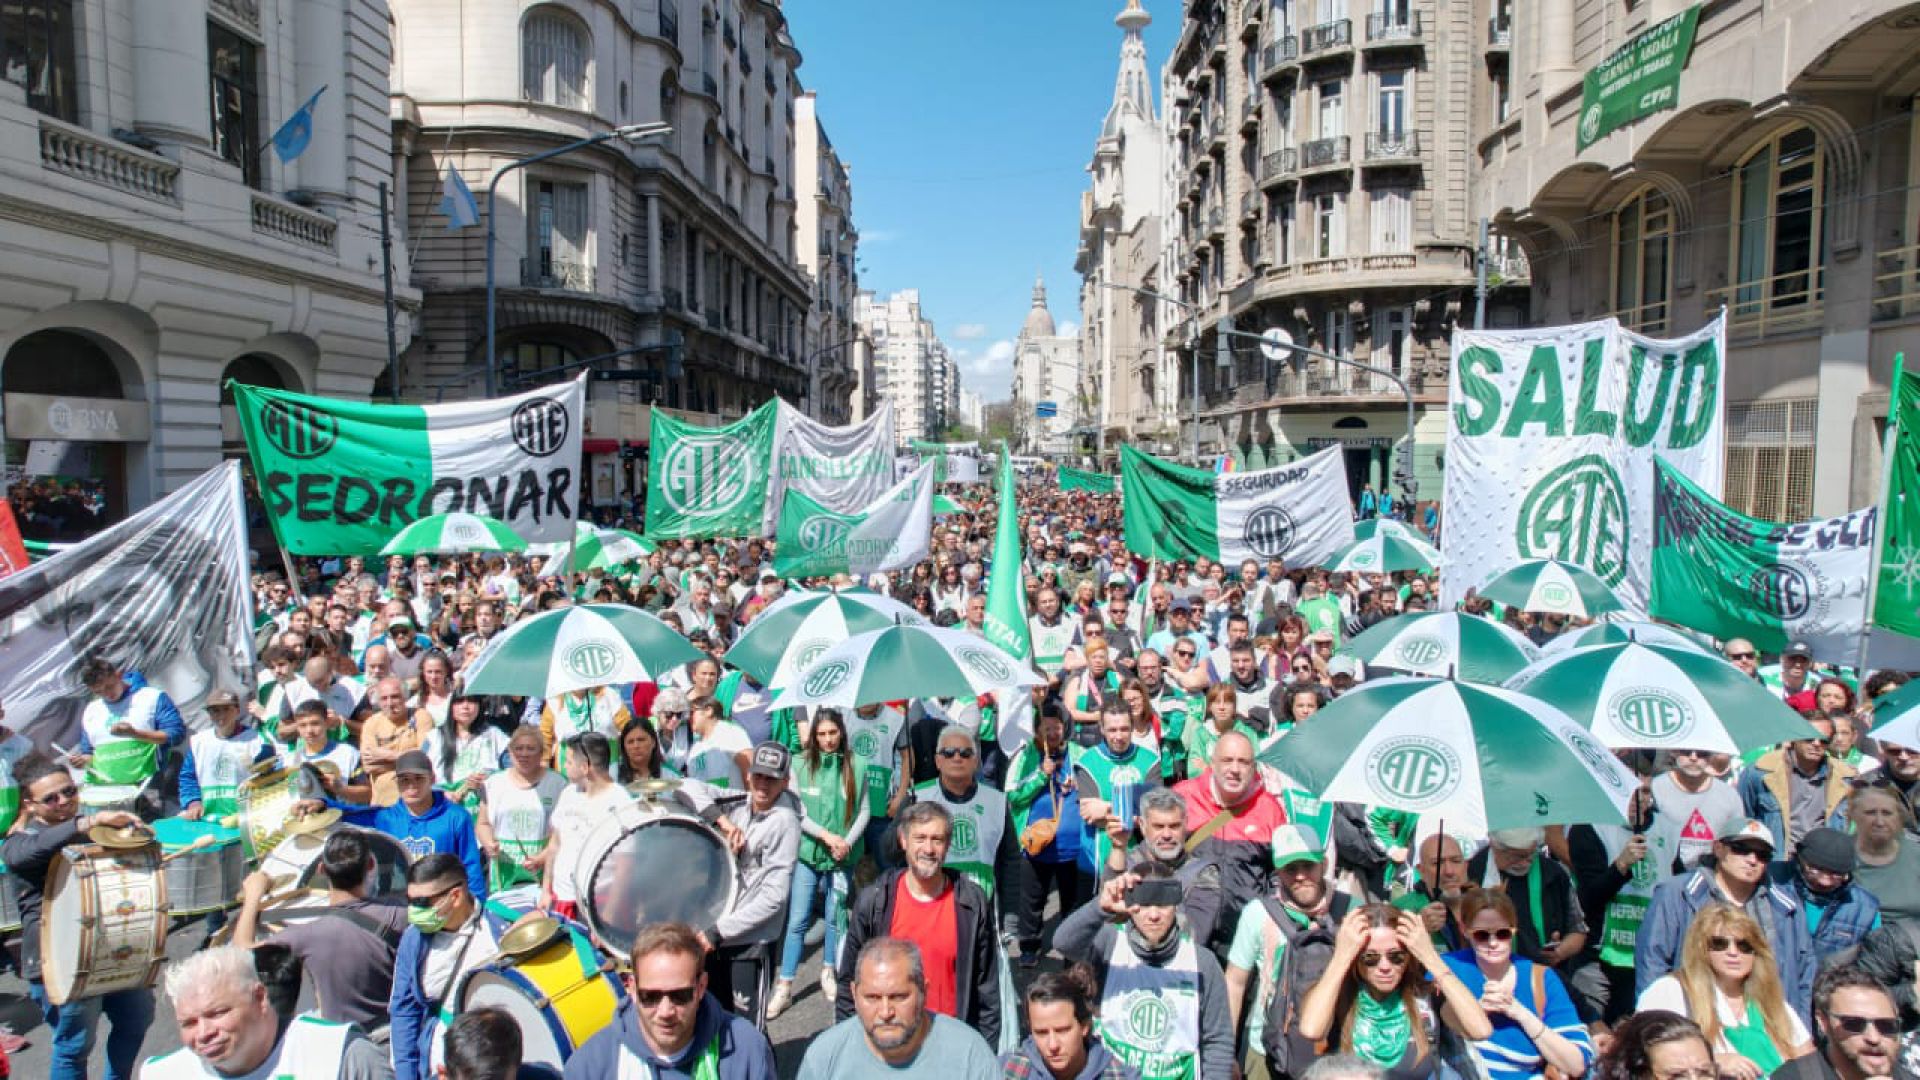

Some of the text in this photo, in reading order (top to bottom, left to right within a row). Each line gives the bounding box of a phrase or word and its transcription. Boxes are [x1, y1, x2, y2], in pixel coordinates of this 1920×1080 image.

[1453, 337, 1720, 449] SALUD
[268, 401, 332, 454] ATE
[515, 399, 566, 453] ATE
[266, 466, 571, 525] SEDRONAR
[669, 443, 744, 509] ATE
[1226, 466, 1309, 492] SEGURIDAD
[1249, 513, 1293, 554] ATE
[1532, 470, 1624, 583] ATE
[574, 647, 613, 675] ATE
[1403, 641, 1441, 663] ATE
[806, 661, 847, 694] ATE
[1624, 698, 1682, 735] ATE
[1382, 749, 1442, 794] ATE
[1132, 1003, 1166, 1038] ATE
